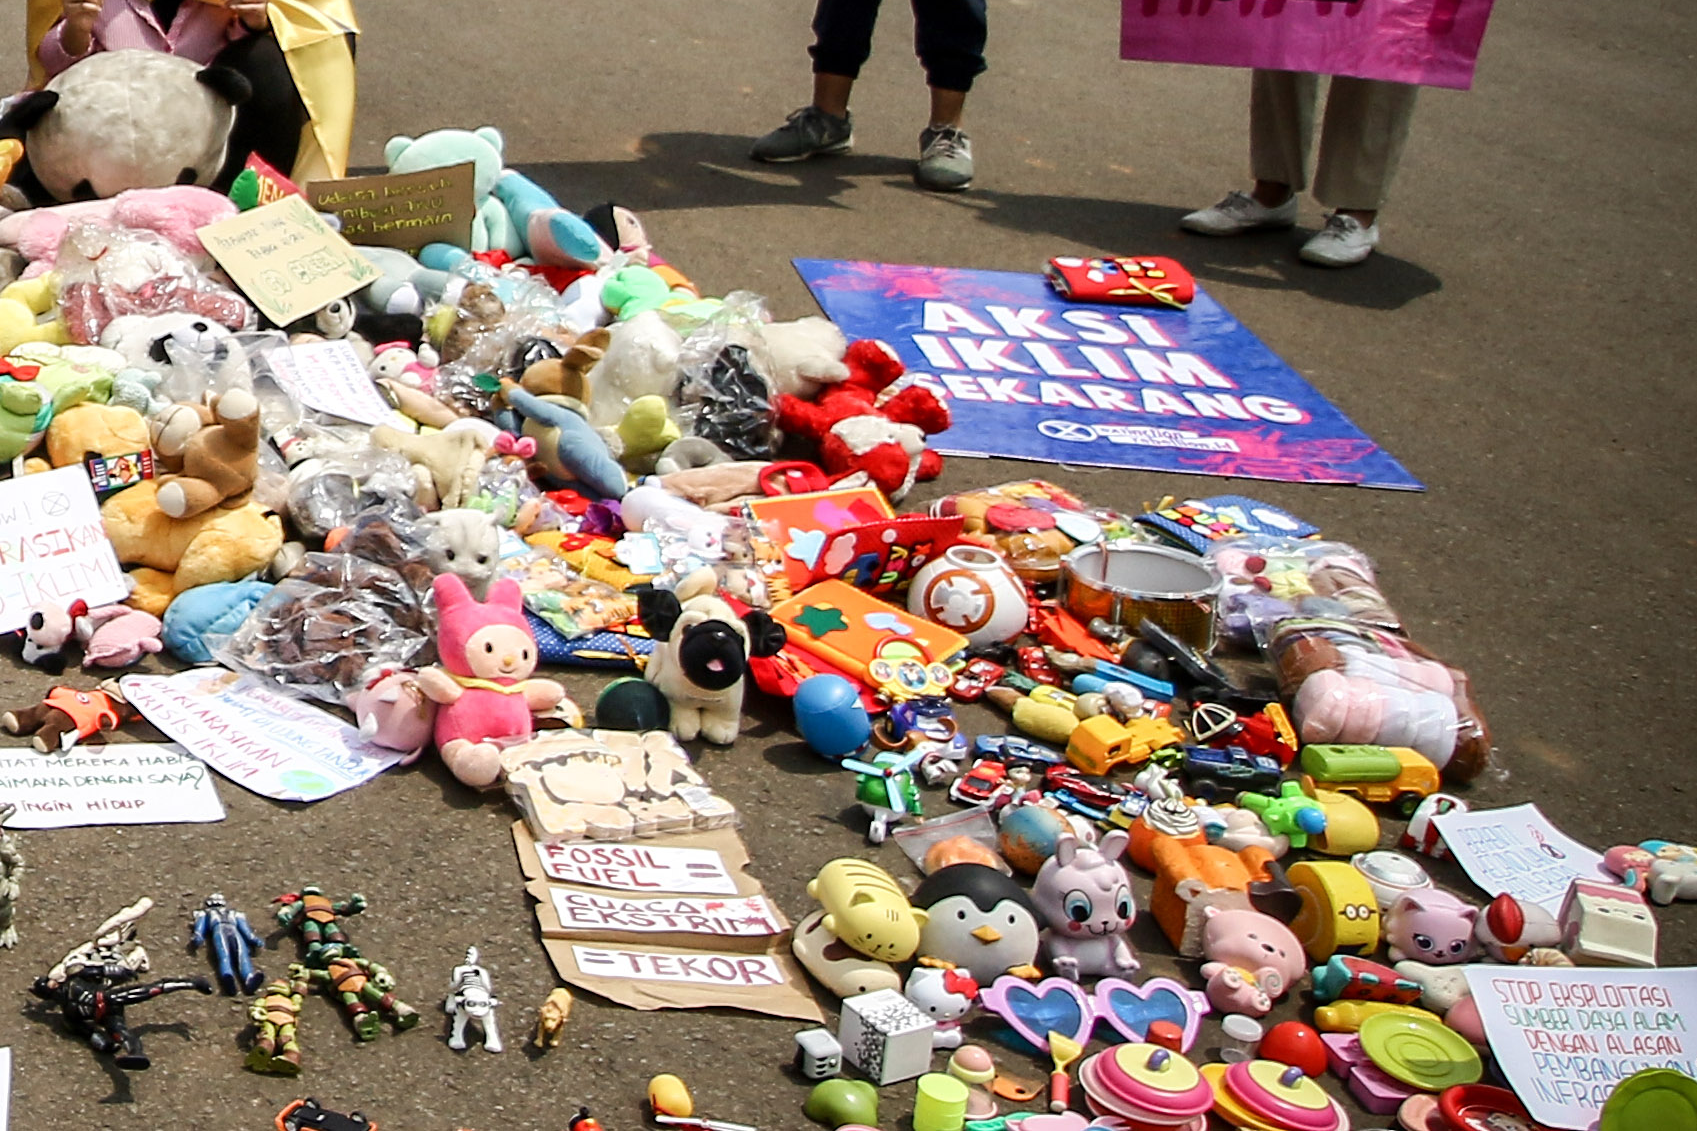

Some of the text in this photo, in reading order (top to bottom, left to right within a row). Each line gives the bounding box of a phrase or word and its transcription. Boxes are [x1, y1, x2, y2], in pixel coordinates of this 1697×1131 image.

[921, 299, 1177, 348] AKSI
[911, 333, 1236, 391] IKLIM
[913, 372, 1310, 425] SEKARANG
[45, 756, 130, 769] MEREKA
[74, 773, 144, 787] DENGAN
[546, 844, 670, 870] FOSSIL
[550, 863, 661, 888] FUEL
[565, 894, 701, 915] CUACA
[618, 952, 778, 984] TEKOR
[1491, 979, 1673, 1008] STOP EKSPLOITASI
[1503, 1005, 1688, 1032] SUMBER DAYA ALAM
[1523, 1029, 1683, 1056] DENGAN ALASAN
